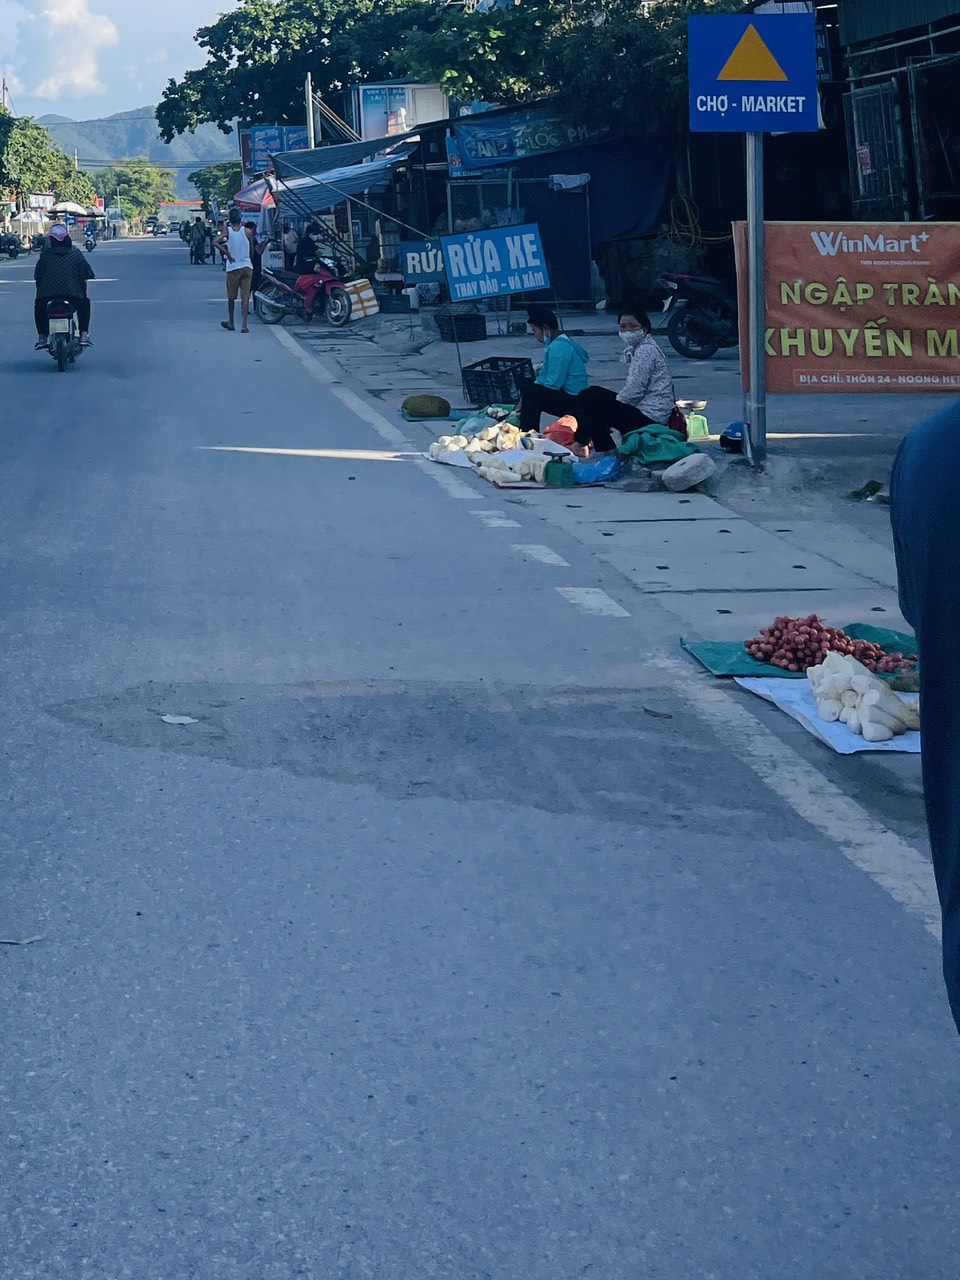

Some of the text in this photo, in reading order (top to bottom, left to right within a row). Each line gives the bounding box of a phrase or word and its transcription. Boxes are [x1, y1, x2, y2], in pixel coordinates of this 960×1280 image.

[696, 94, 729, 117] CHỢ
[741, 96, 806, 113] MARKET
[406, 242, 445, 274] RỬA
[447, 233, 541, 278] RỬA XE
[454, 280, 478, 298] THAY
[508, 272, 522, 290] VÁ
[780, 276, 874, 312] NGẬP
[799, 374, 818, 385] ĐỊA
[820, 372, 844, 384] CHỈ:
[846, 373, 876, 384] THÔN
[878, 375, 891, 384] 24
